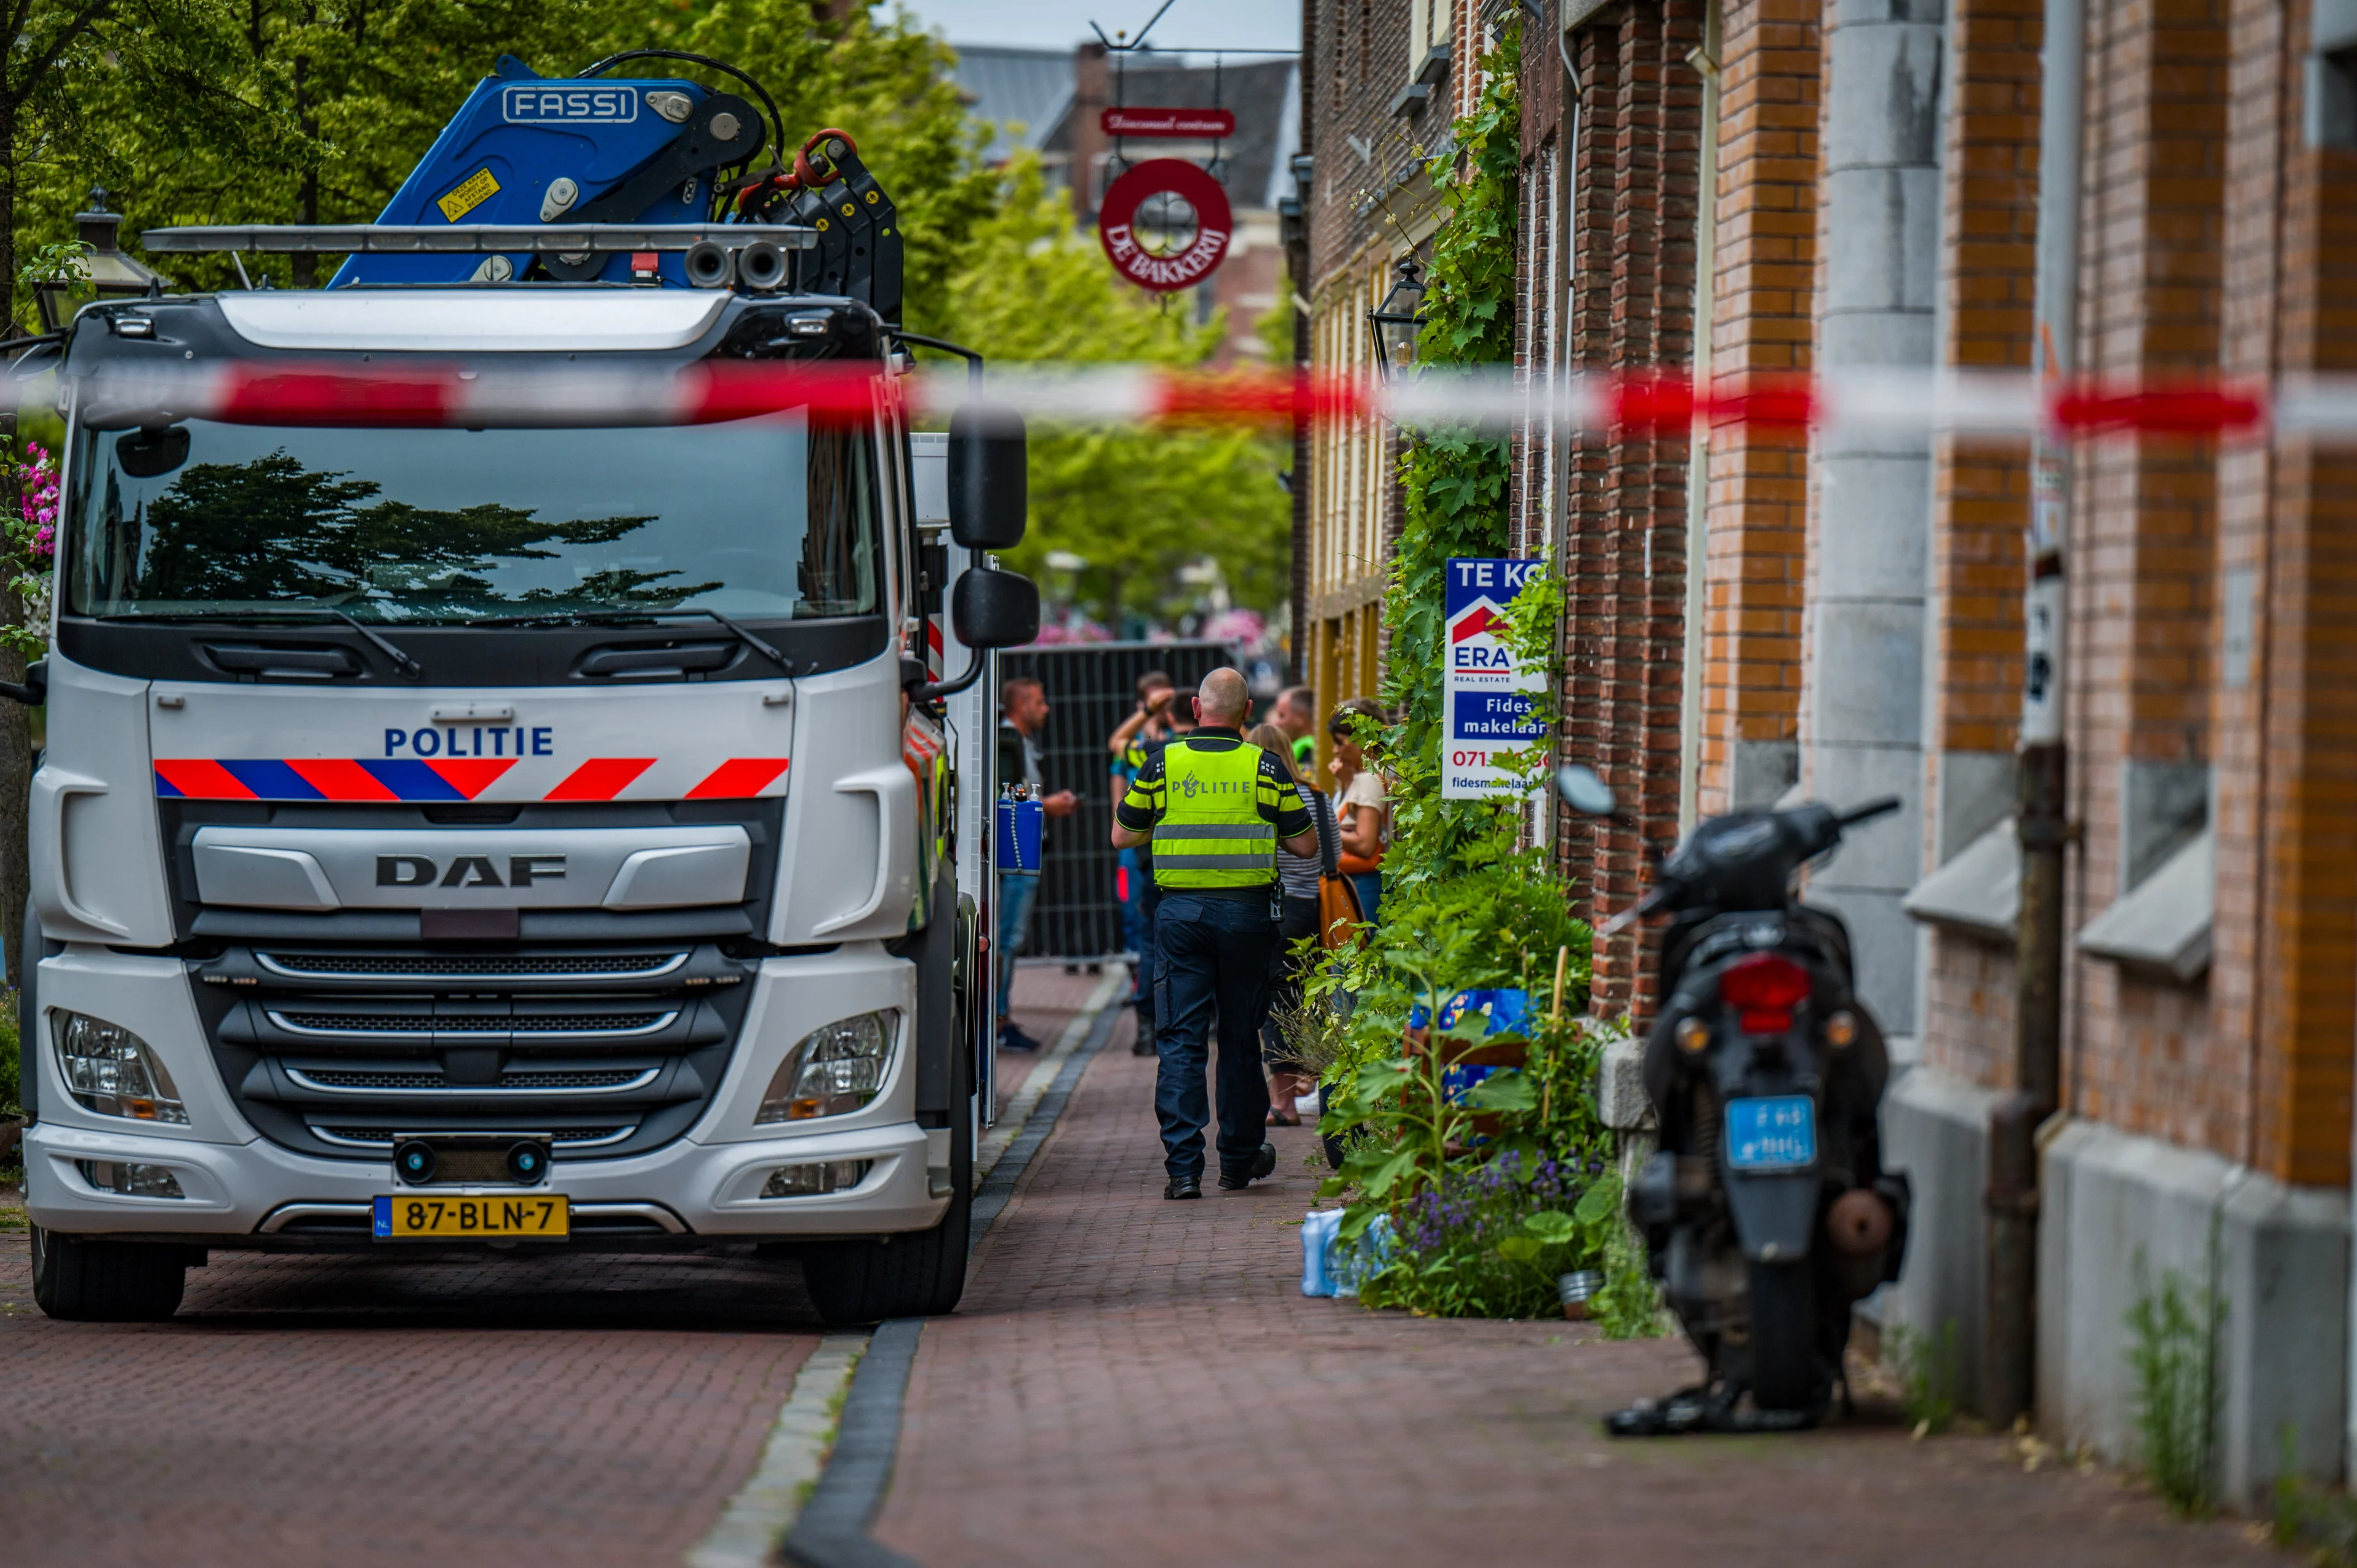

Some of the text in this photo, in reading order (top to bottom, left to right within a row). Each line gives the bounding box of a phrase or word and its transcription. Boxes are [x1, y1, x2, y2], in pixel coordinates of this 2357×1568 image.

[516, 94, 625, 115] FASSI
[452, 169, 488, 196] DEZE KRAAN
[459, 182, 479, 199] WORDT
[465, 183, 490, 203] AFSTAND
[467, 189, 492, 208] BEDIEND
[1106, 223, 1228, 284] DE BAKKERIJ
[1456, 562, 1493, 587] TE
[1455, 647, 1510, 667] ERA
[1487, 698, 1532, 713] Fides
[385, 727, 553, 757] POLITIE
[1452, 751, 1485, 767] 071
[376, 853, 567, 887] DAF
[377, 1202, 554, 1230] NL 87-BLN-7
